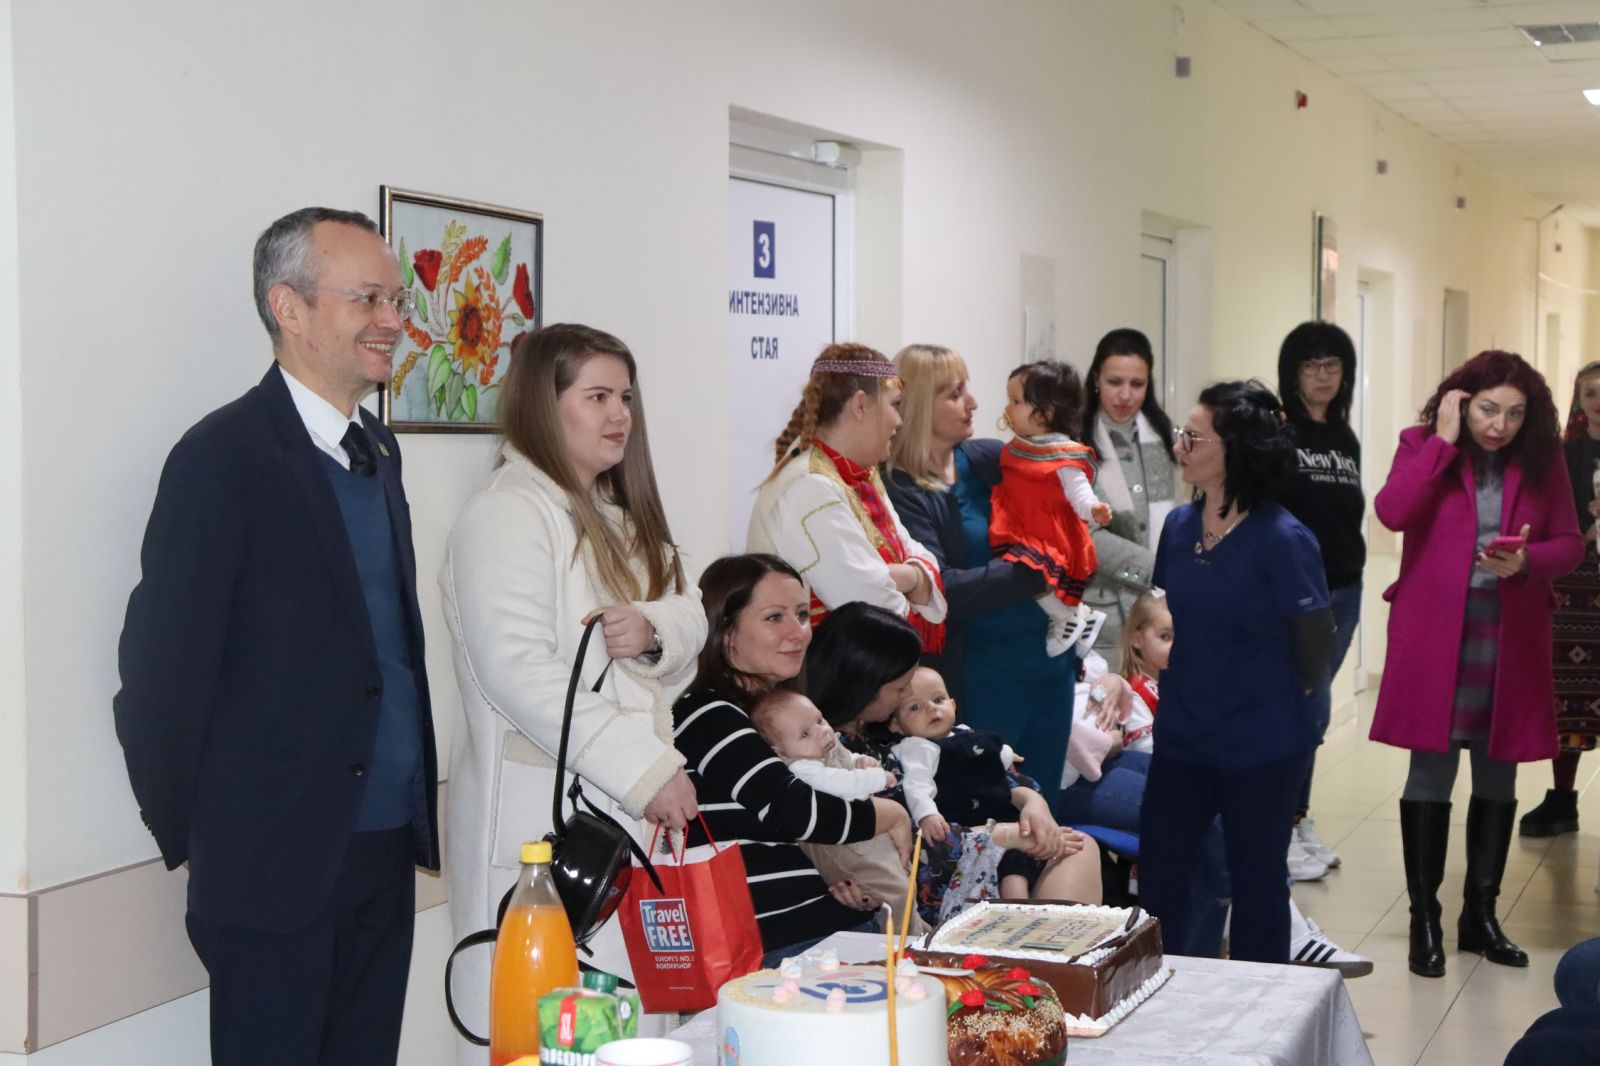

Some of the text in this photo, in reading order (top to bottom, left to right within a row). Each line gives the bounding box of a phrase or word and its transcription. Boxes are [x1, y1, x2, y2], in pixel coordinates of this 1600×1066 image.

[758, 233, 771, 269] 3
[729, 290, 799, 317] ИНТЕНЗИВНА
[751, 336, 778, 360] СТАЯ
[1295, 448, 1332, 468] New
[642, 903, 685, 923] Travel
[647, 925, 691, 947] FREE
